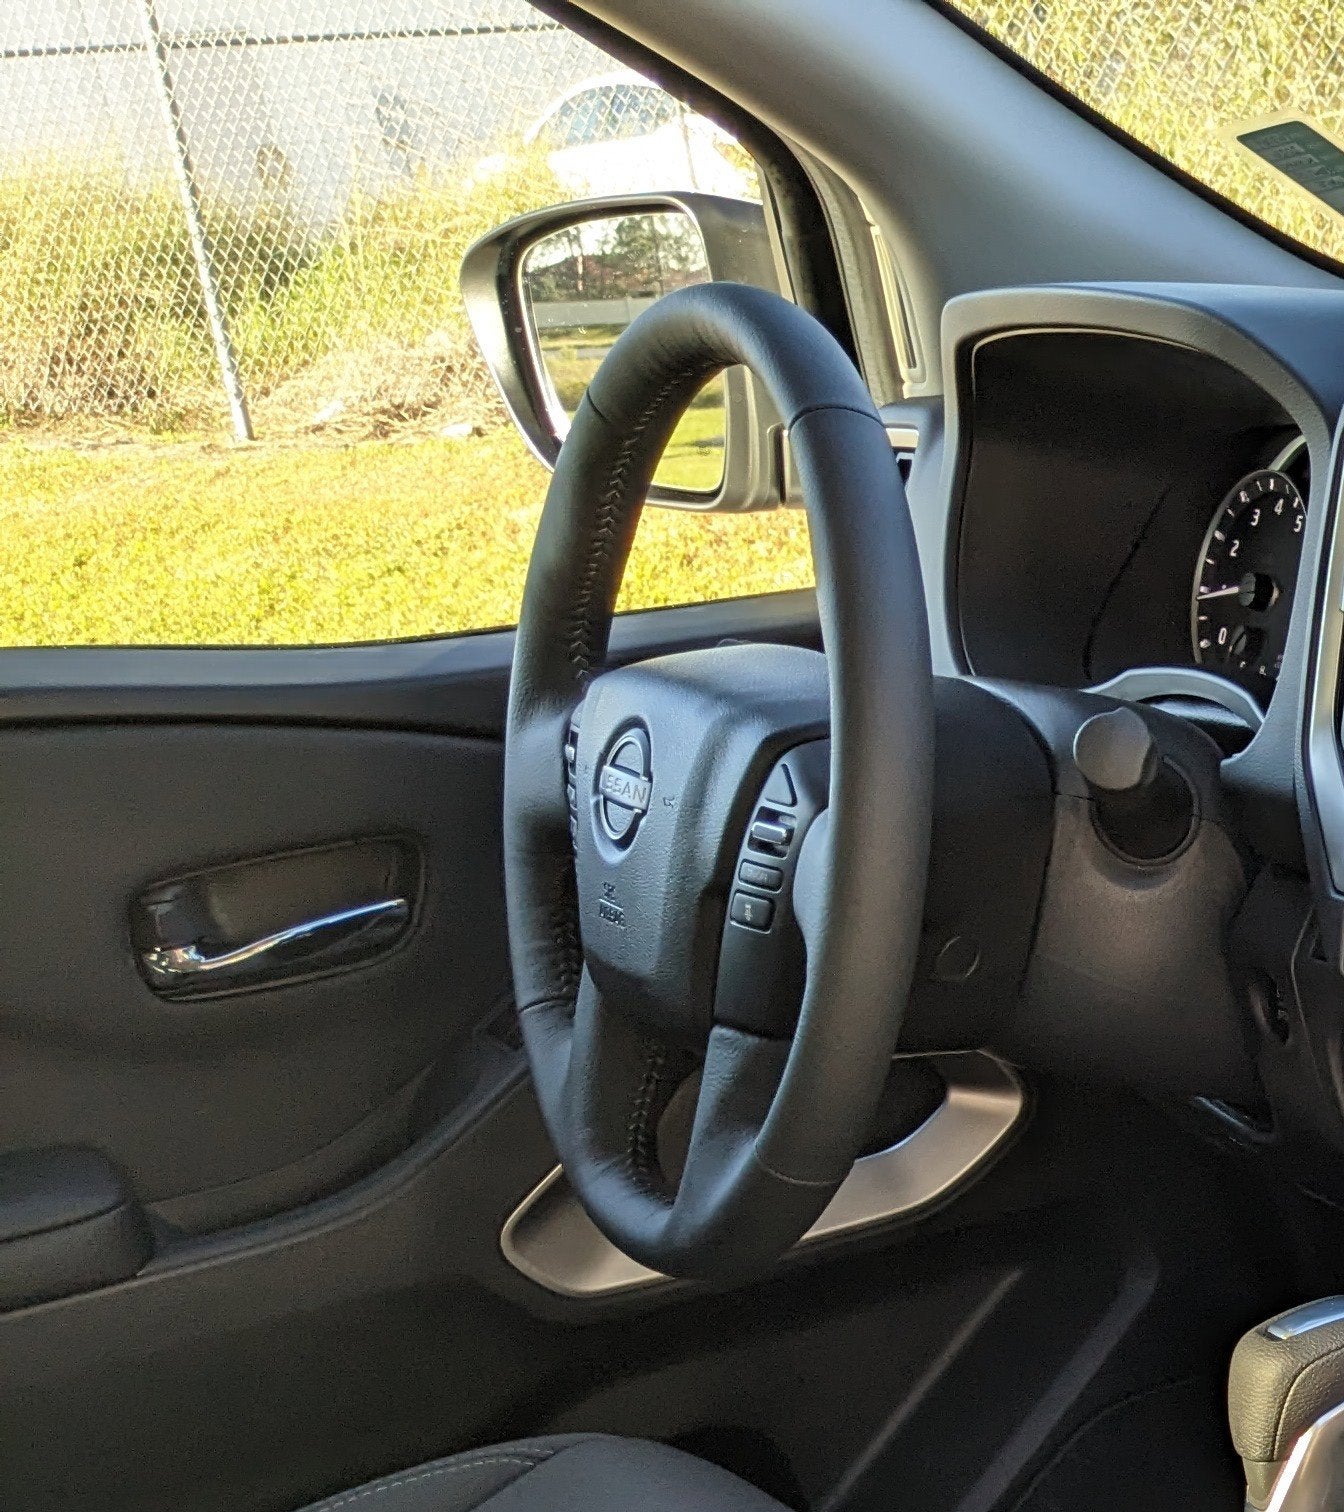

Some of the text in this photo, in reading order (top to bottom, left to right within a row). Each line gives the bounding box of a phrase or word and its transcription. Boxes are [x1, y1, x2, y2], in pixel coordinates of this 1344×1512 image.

[1274, 498, 1284, 516] 4
[1250, 508, 1261, 527] 3
[1293, 515, 1304, 533] 5
[1229, 539, 1240, 557] 2
[1218, 627, 1227, 645] 0
[602, 771, 648, 803] SSAN
